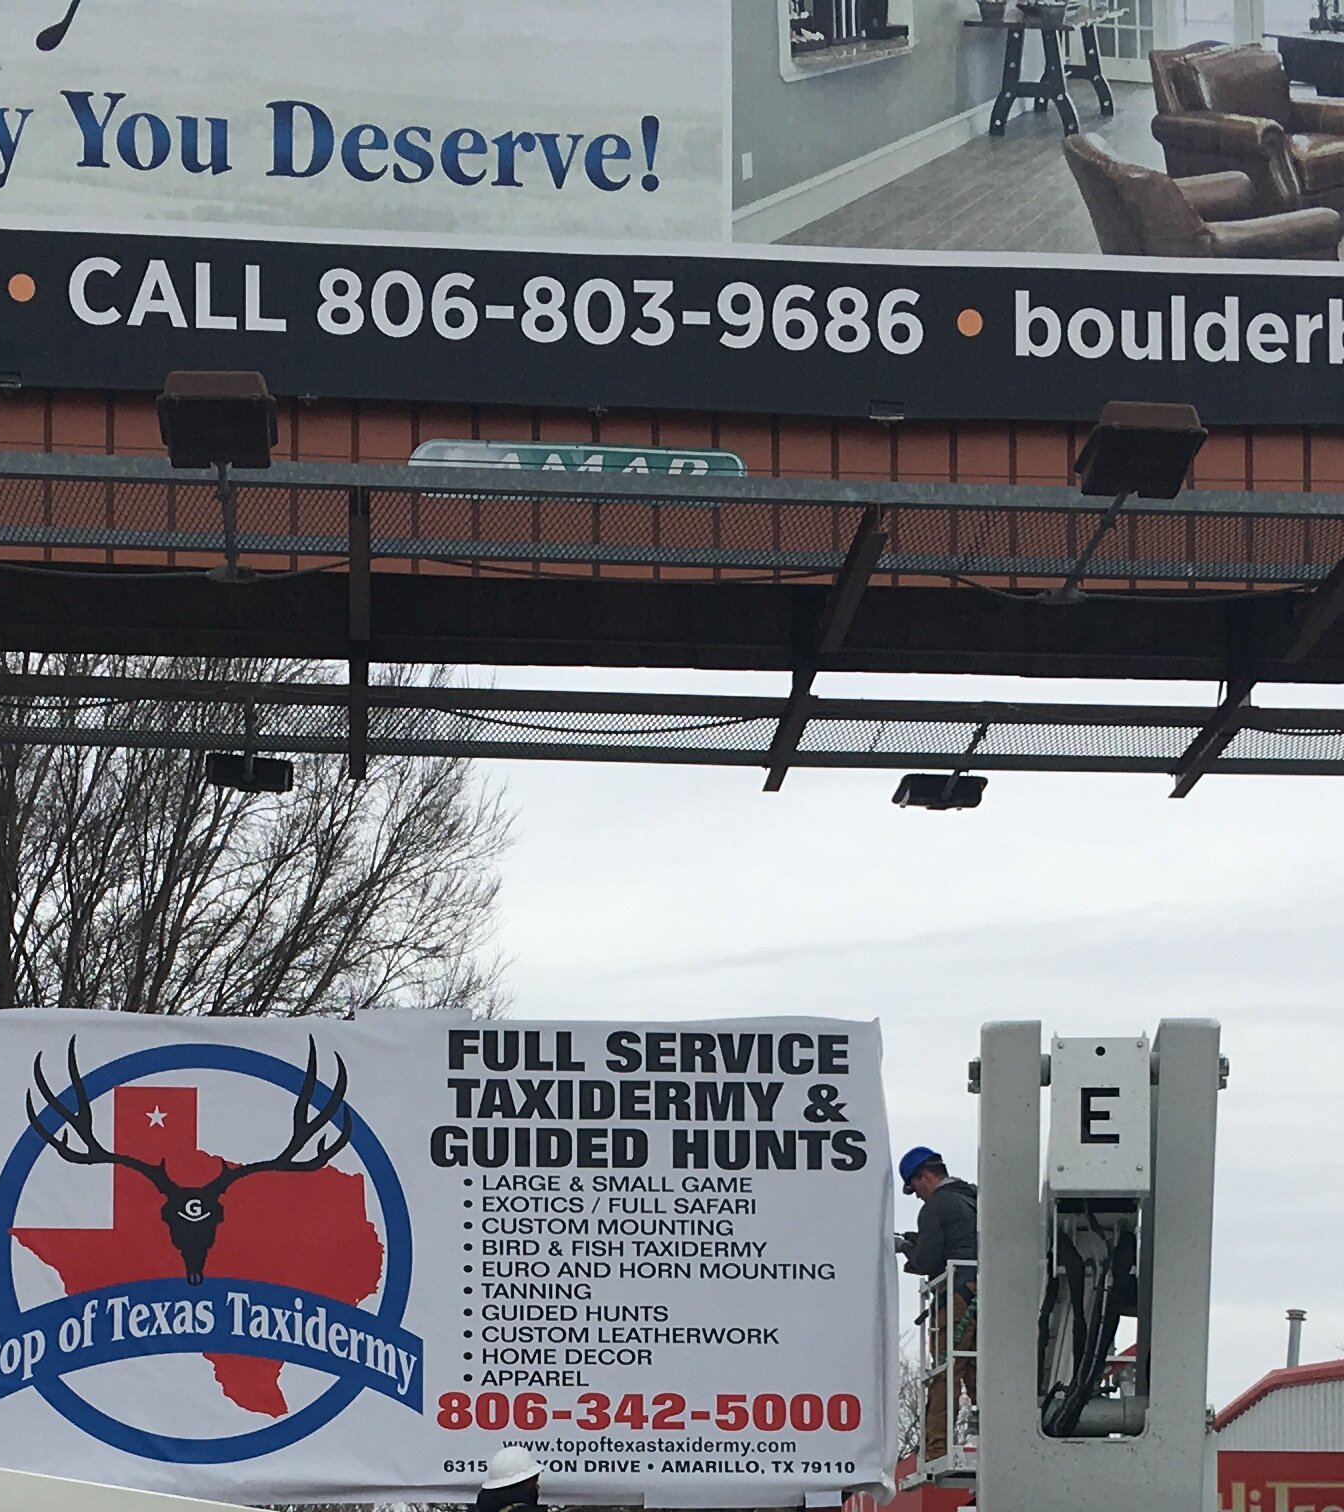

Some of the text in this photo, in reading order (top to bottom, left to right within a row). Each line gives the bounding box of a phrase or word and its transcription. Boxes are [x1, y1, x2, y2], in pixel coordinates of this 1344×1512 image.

[60, 90, 232, 175] You
[266, 101, 659, 192] Deserve!
[69, 257, 286, 331] CALL
[317, 270, 924, 354] 806-803-9686
[449, 1030, 849, 1075] FULL SERVICE
[448, 1078, 849, 1123] TAXIDERMY &
[1080, 1087, 1120, 1144] E
[431, 1126, 867, 1171] GUIDED HUNTS
[483, 1175, 752, 1193] LARGE & SMALL GAME
[185, 1199, 202, 1216] G
[483, 1196, 755, 1214] EXOTICS / FULL SAFARI
[482, 1218, 733, 1236] CUSTOM MOUNTING
[483, 1240, 767, 1257] BIRD & FISH TAXIDERMY
[483, 1262, 835, 1280] EURO AND HORN MOUNTING
[481, 1283, 591, 1299] TANNING
[482, 1305, 668, 1322] GUIDED HUNTS
[59, 1298, 98, 1353] of
[106, 1295, 216, 1342] Texas
[225, 1291, 418, 1396] Taxidermy
[482, 1326, 779, 1344] CUSTOM LEATHERWORK
[483, 1348, 652, 1365] HOME DECOR
[481, 1370, 589, 1386] APPAREL
[437, 1392, 861, 1431] 806-342-5000
[444, 1460, 488, 1472] 6315
[585, 1461, 640, 1472] DRIVE
[661, 1461, 764, 1474] AMARILLO,
[771, 1461, 793, 1473] TX
[801, 1462, 855, 1473] 79110
